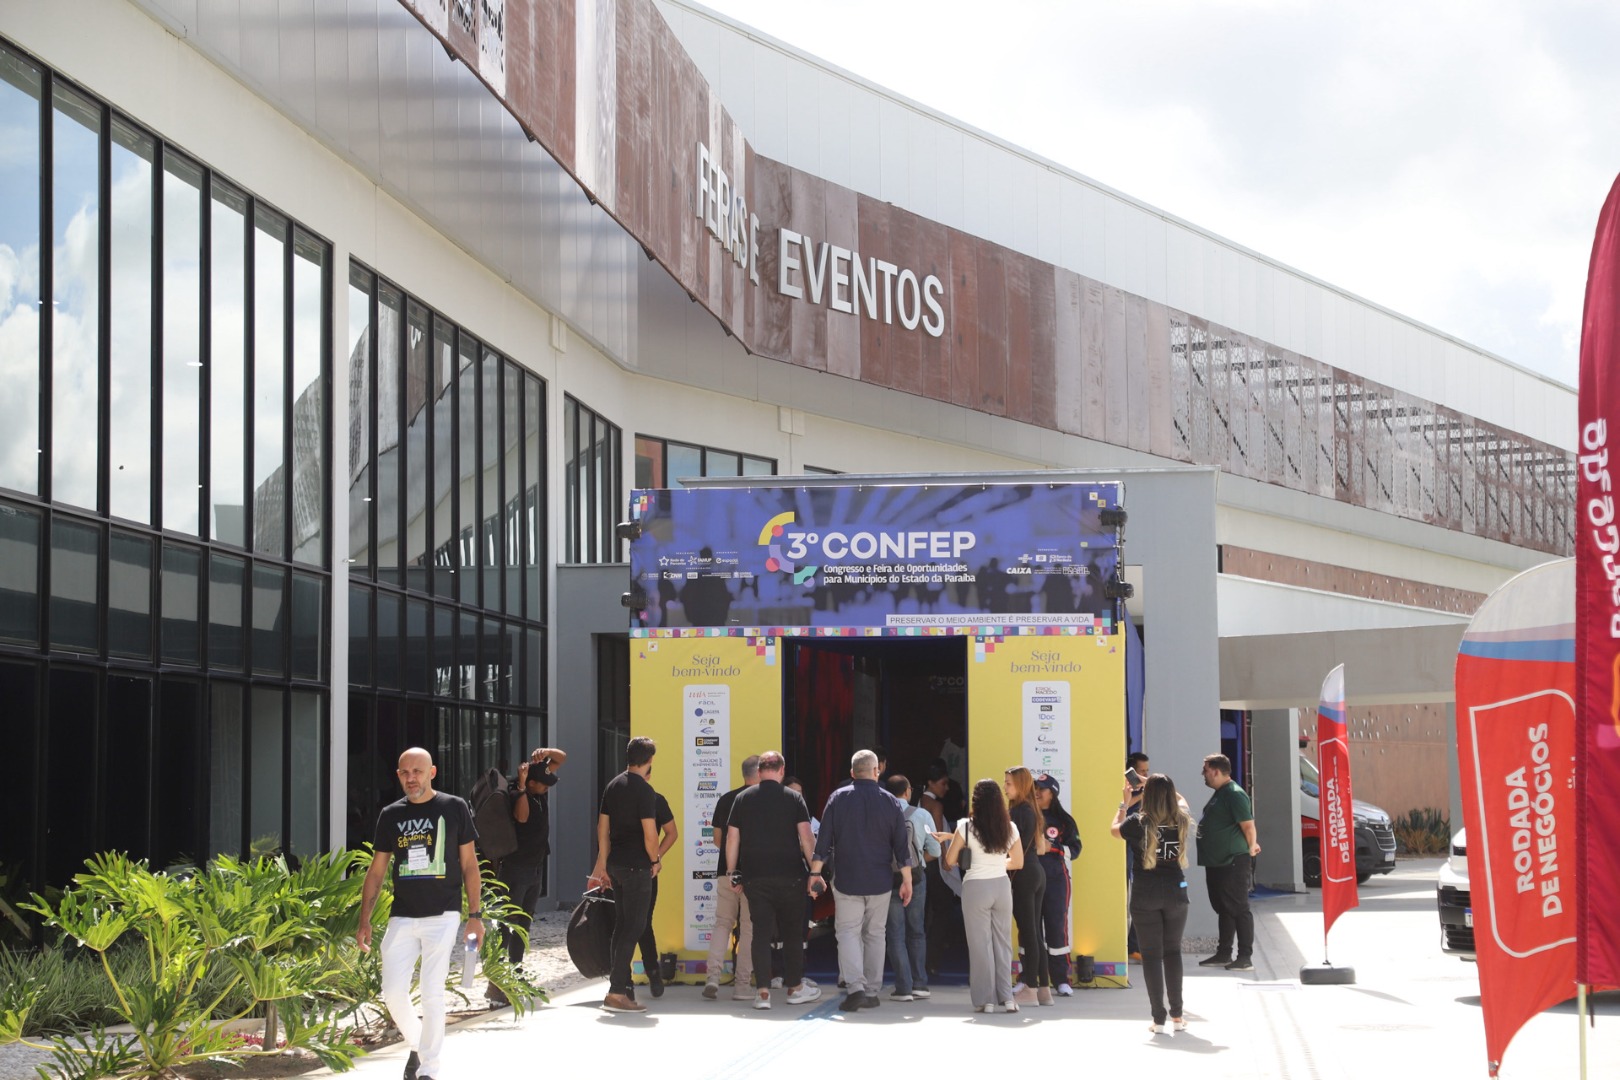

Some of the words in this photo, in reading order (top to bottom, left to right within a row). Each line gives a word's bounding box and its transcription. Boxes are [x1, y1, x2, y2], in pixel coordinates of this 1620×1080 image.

[749, 212, 760, 287] E
[777, 227, 945, 338] EVENTOS
[822, 531, 976, 560] CONFEP
[823, 564, 864, 575] Congresso
[873, 564, 892, 573] Feira
[894, 563, 905, 573] de
[907, 563, 968, 575] Oportunidades
[1006, 567, 1032, 575] CAIXA
[823, 576, 842, 585] para
[844, 574, 887, 586] Municípios
[889, 574, 900, 583] do
[902, 574, 930, 583] Estado
[931, 574, 942, 583] da
[944, 573, 976, 583] Paraíba
[890, 616, 937, 625] PRESERVAR
[946, 616, 966, 624] MEIO
[967, 616, 1006, 624] AMBIENTE
[1008, 614, 1014, 623] É
[1015, 616, 1063, 624] PRESERVAR
[691, 653, 721, 667] Seja
[1030, 650, 1061, 664] Seja
[671, 665, 741, 677] bem-vindo
[1010, 661, 1082, 673] bem-vindo
[1528, 722, 1559, 876] NEGÓCIOS
[396, 818, 434, 832] VIVA
[1505, 765, 1535, 894] RODADA
[397, 834, 433, 843] CAMPINA
[1338, 841, 1350, 863] DE
[1541, 876, 1563, 919] DE
